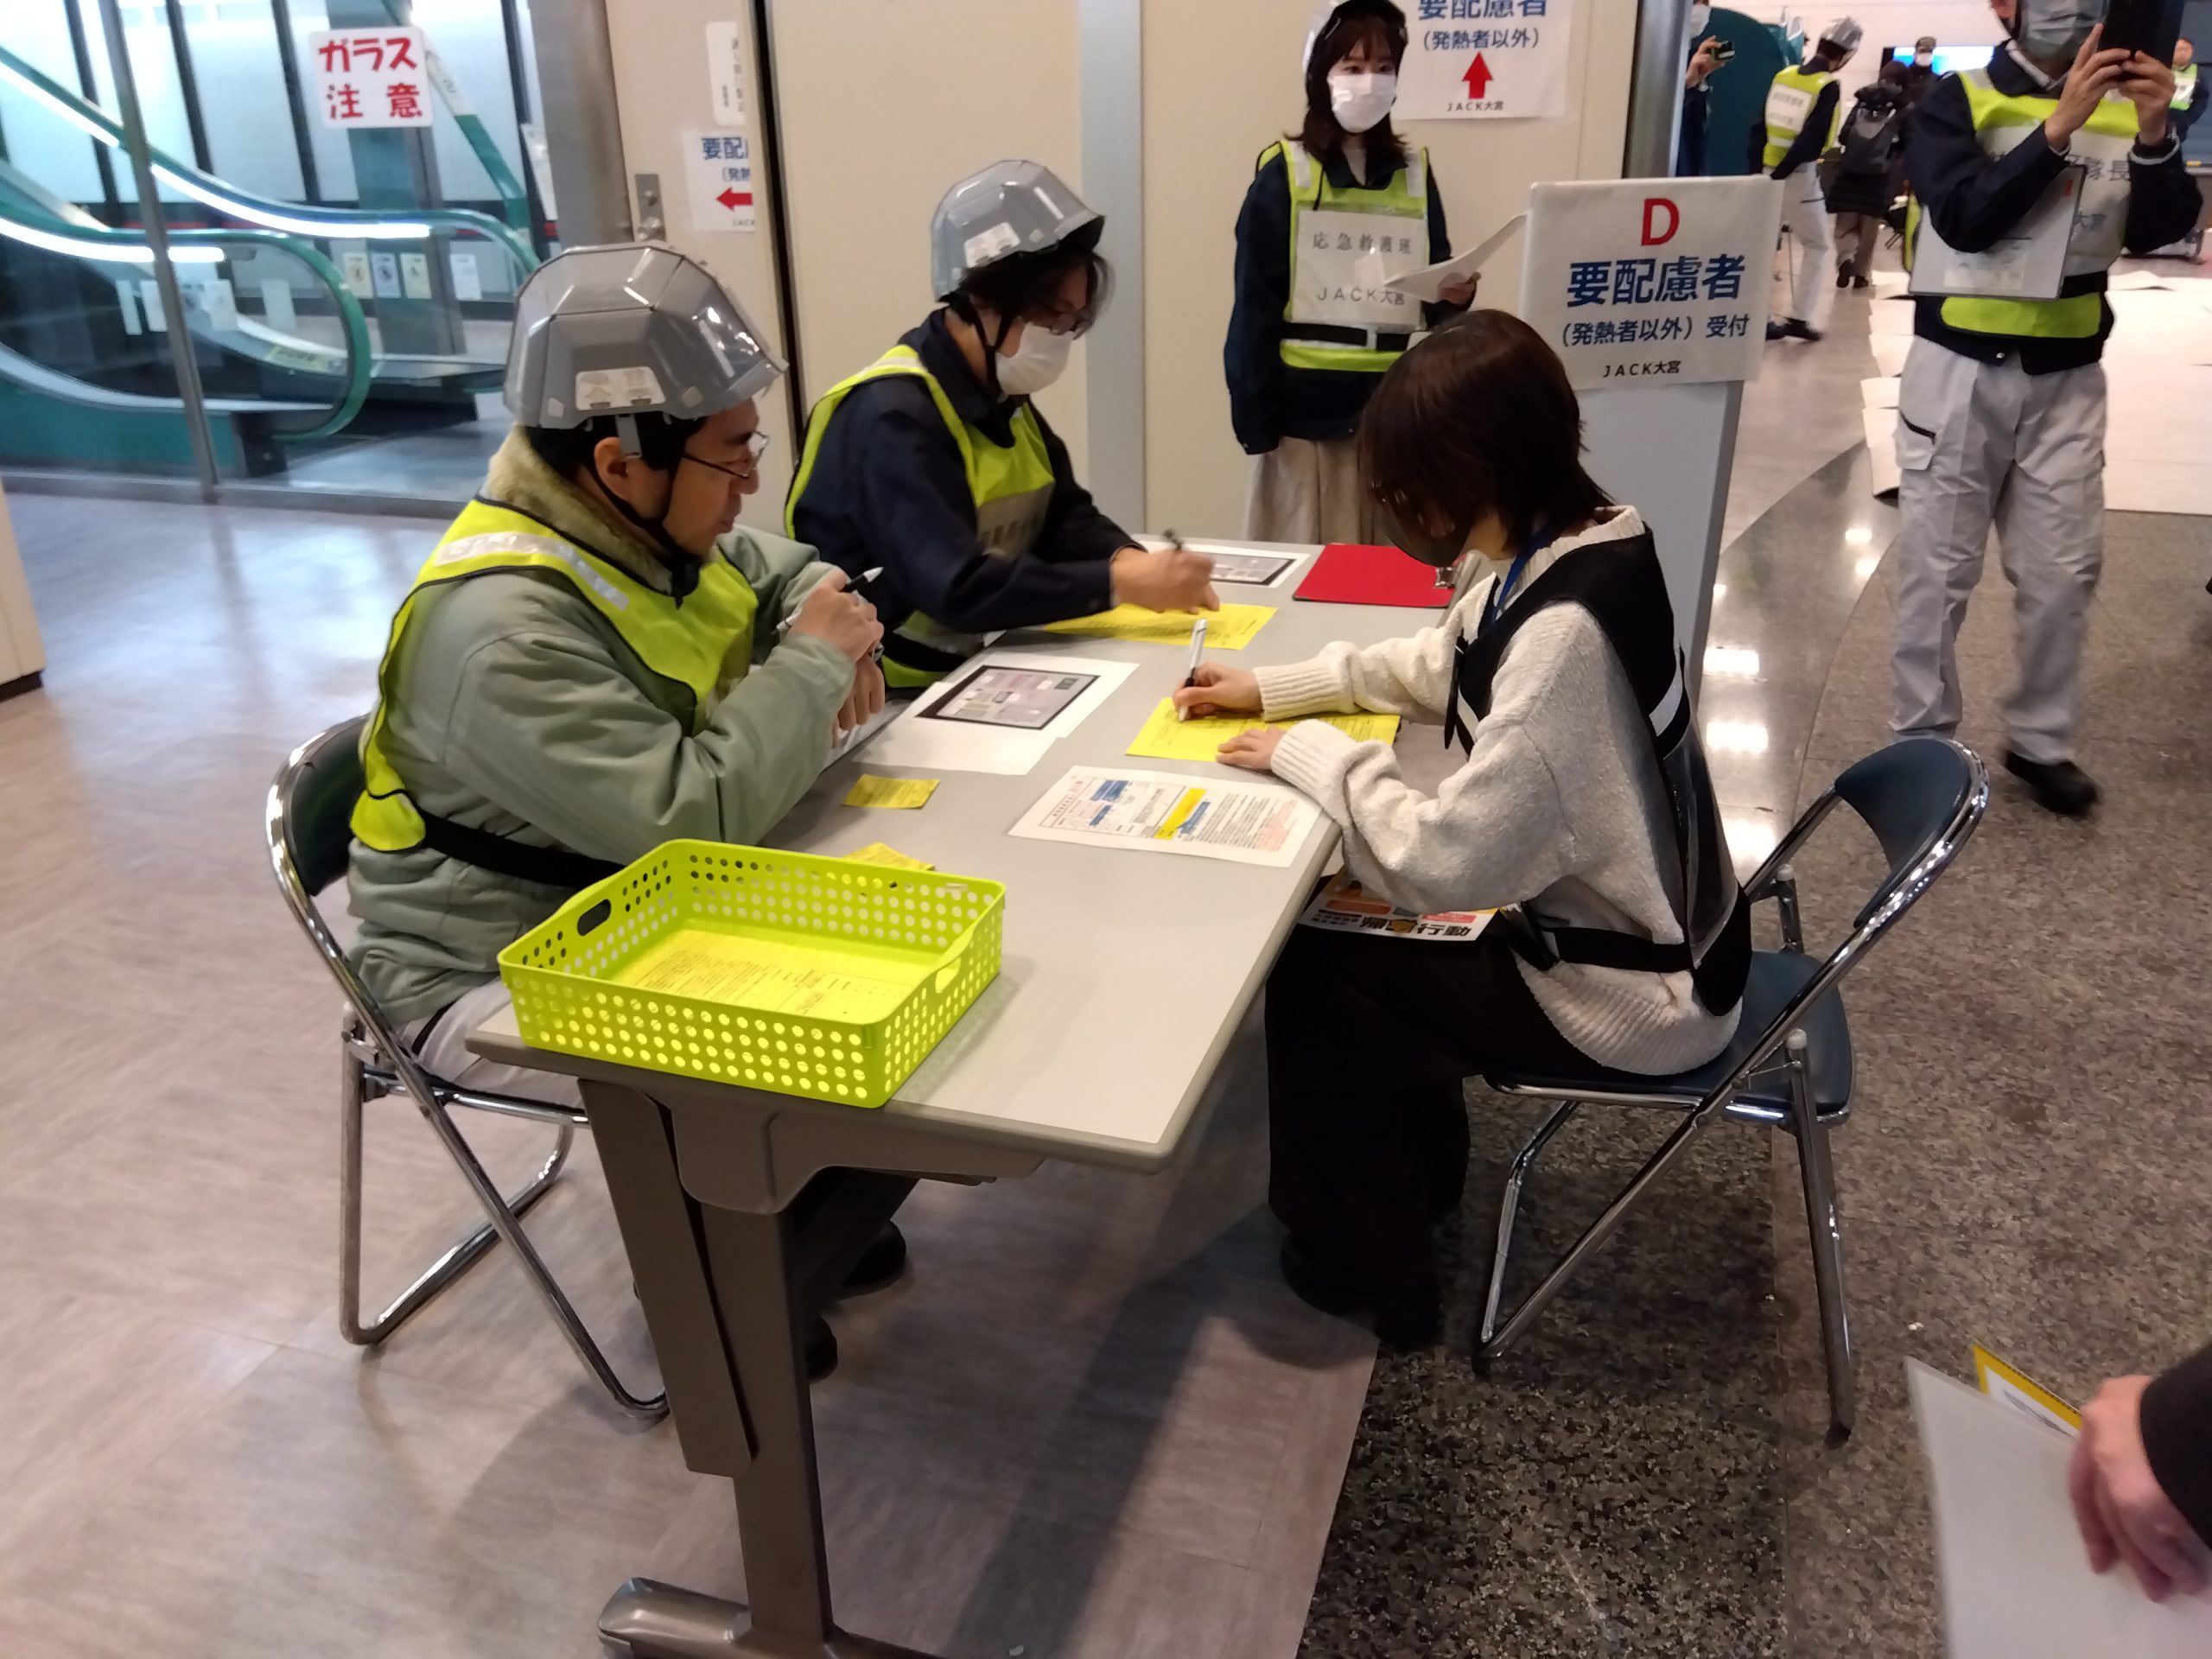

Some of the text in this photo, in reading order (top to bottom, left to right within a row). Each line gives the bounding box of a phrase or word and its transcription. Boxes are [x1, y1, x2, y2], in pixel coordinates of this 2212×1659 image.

[319, 37, 416, 72] ガラス
[1446, 100, 1504, 111] JACK大宮
[702, 137, 749, 160] 要配
[1641, 198, 1680, 246] D
[1567, 253, 1745, 308] 要配慮者
[1603, 360, 1681, 378] JACK大宮
